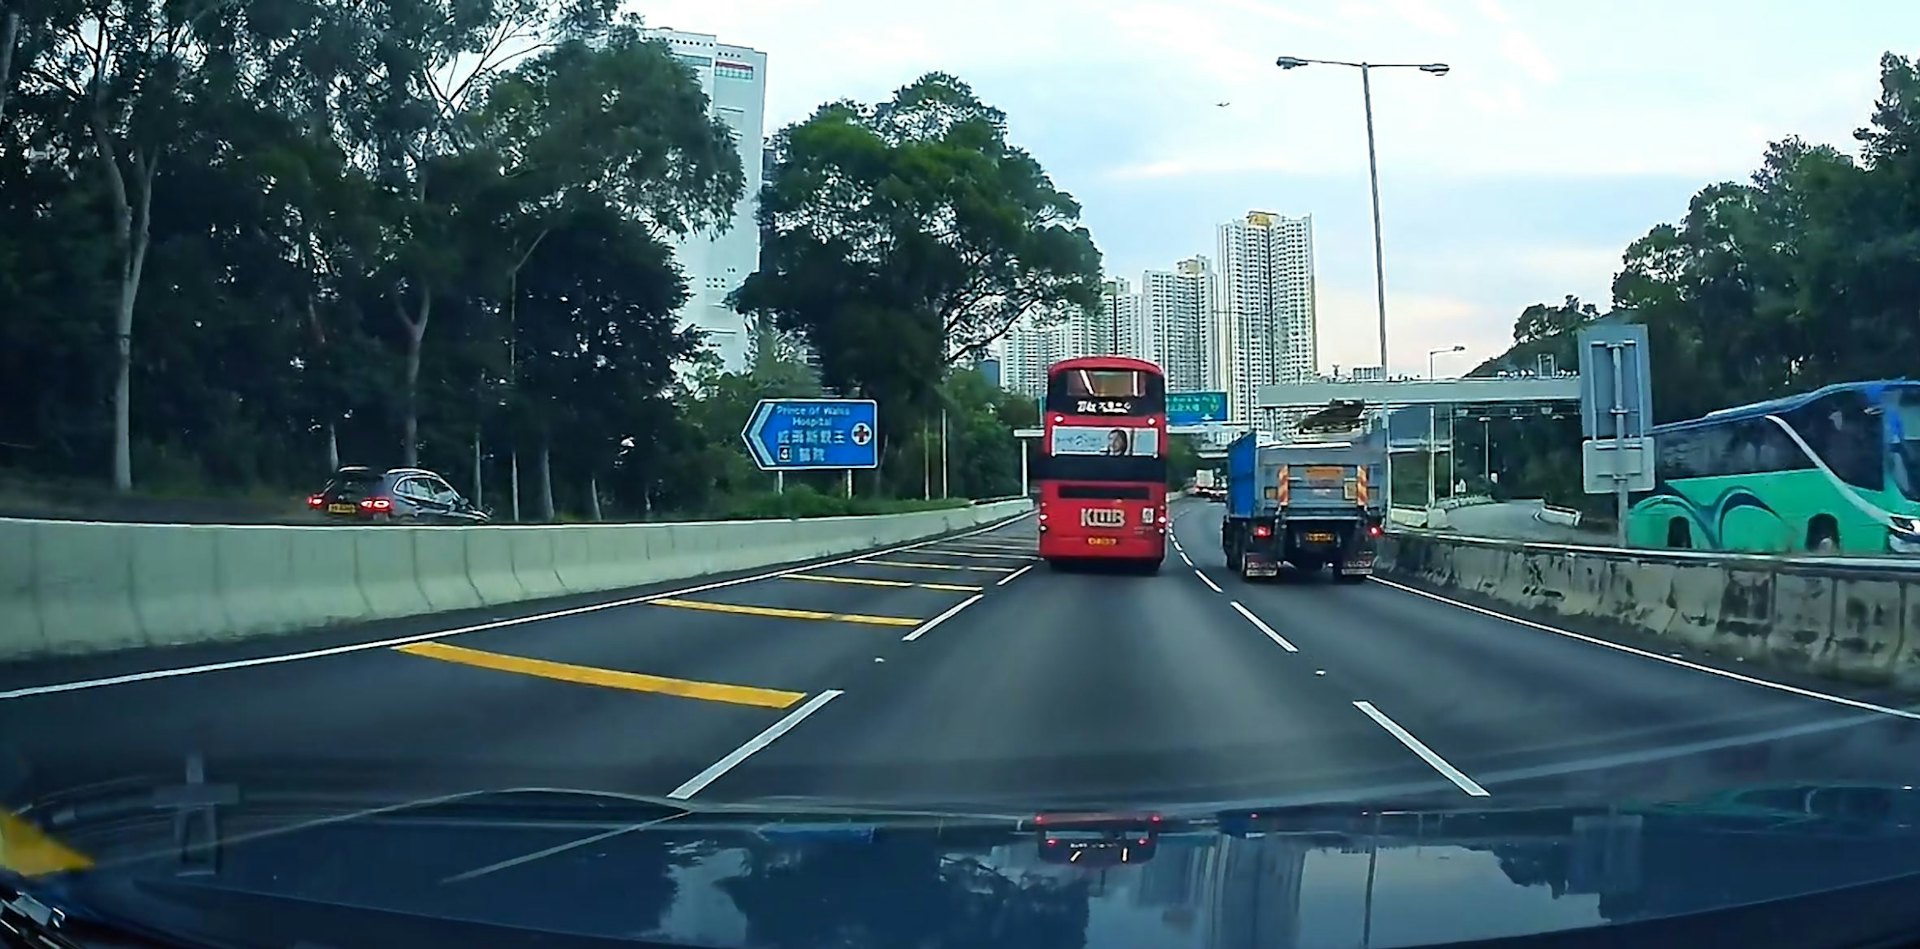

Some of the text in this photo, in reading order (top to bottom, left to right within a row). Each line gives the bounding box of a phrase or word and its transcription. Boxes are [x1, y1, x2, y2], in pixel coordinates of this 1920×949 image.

[776, 405, 851, 416] Prince of Wales
[792, 417, 833, 427] Hospital
[780, 448, 789, 459] 4
[799, 447, 825, 462] 醫院
[1081, 508, 1125, 527] KMB
